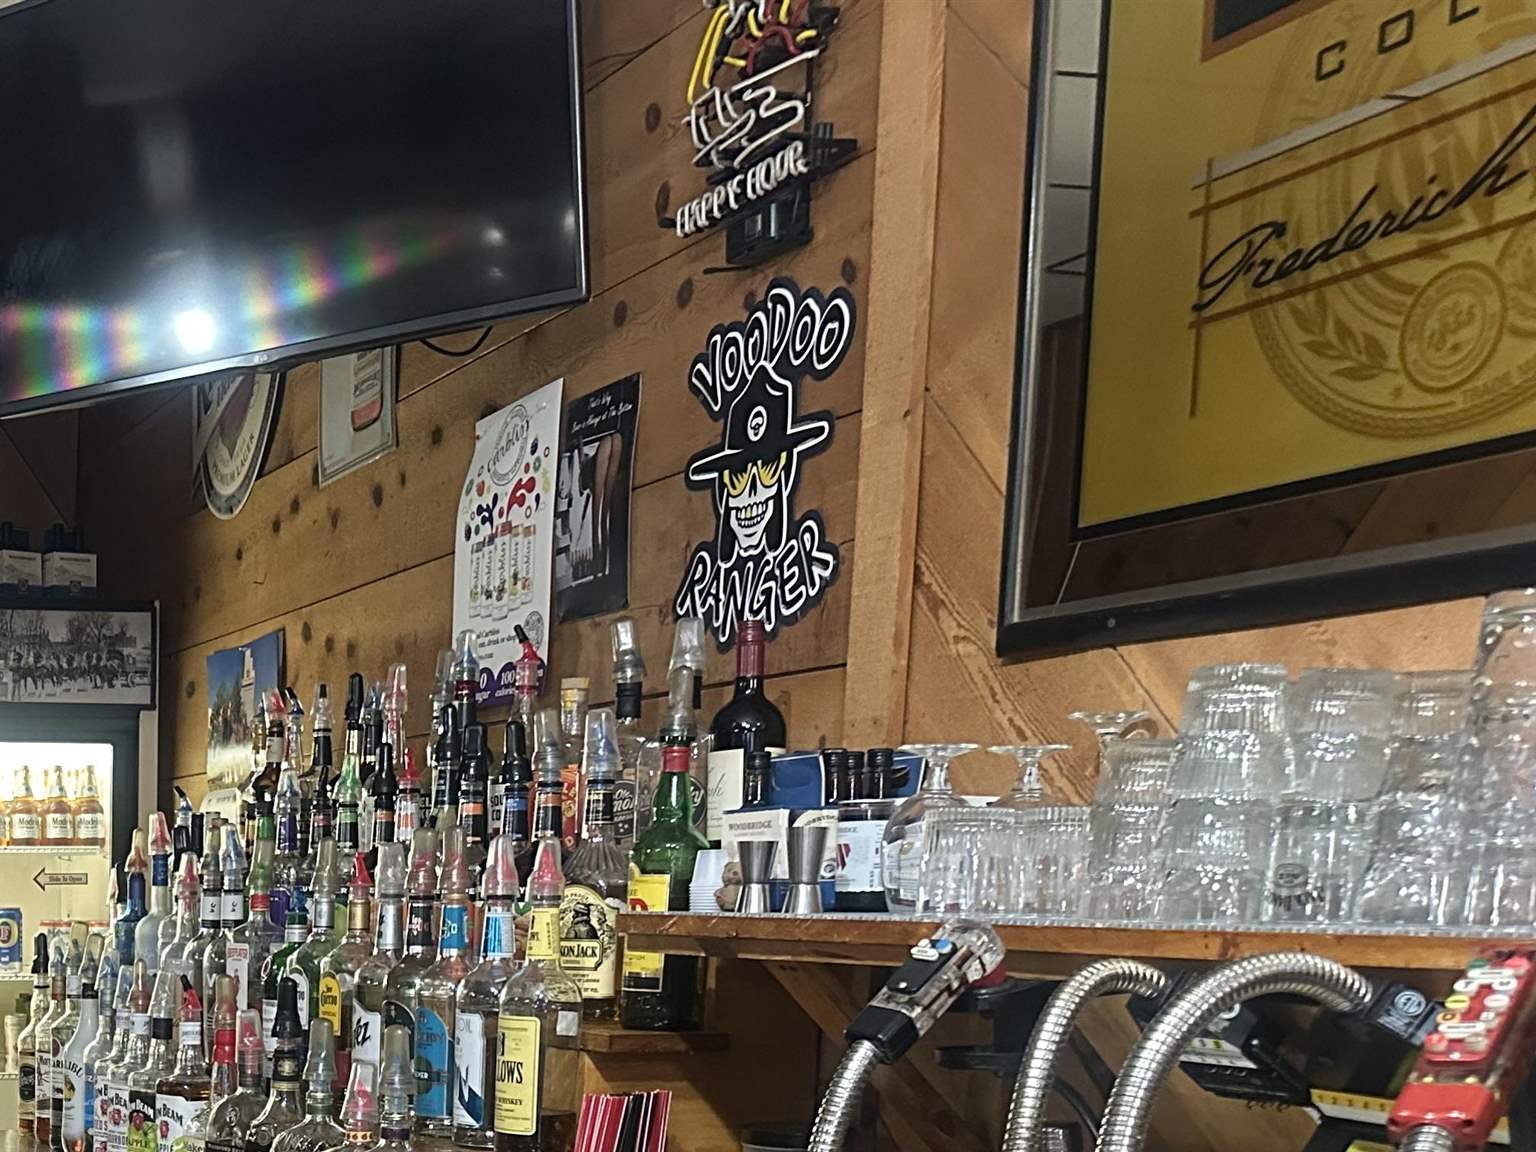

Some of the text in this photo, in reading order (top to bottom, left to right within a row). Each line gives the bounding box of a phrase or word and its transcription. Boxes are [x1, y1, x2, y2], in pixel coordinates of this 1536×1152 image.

[675, 139, 809, 238] HAPPY HOUR
[690, 286, 852, 413] VOODOO
[675, 518, 835, 643] RANGER
[728, 820, 773, 831] WOODBRIDGE
[575, 943, 598, 959] JACK
[162, 1103, 183, 1127] BEAM
